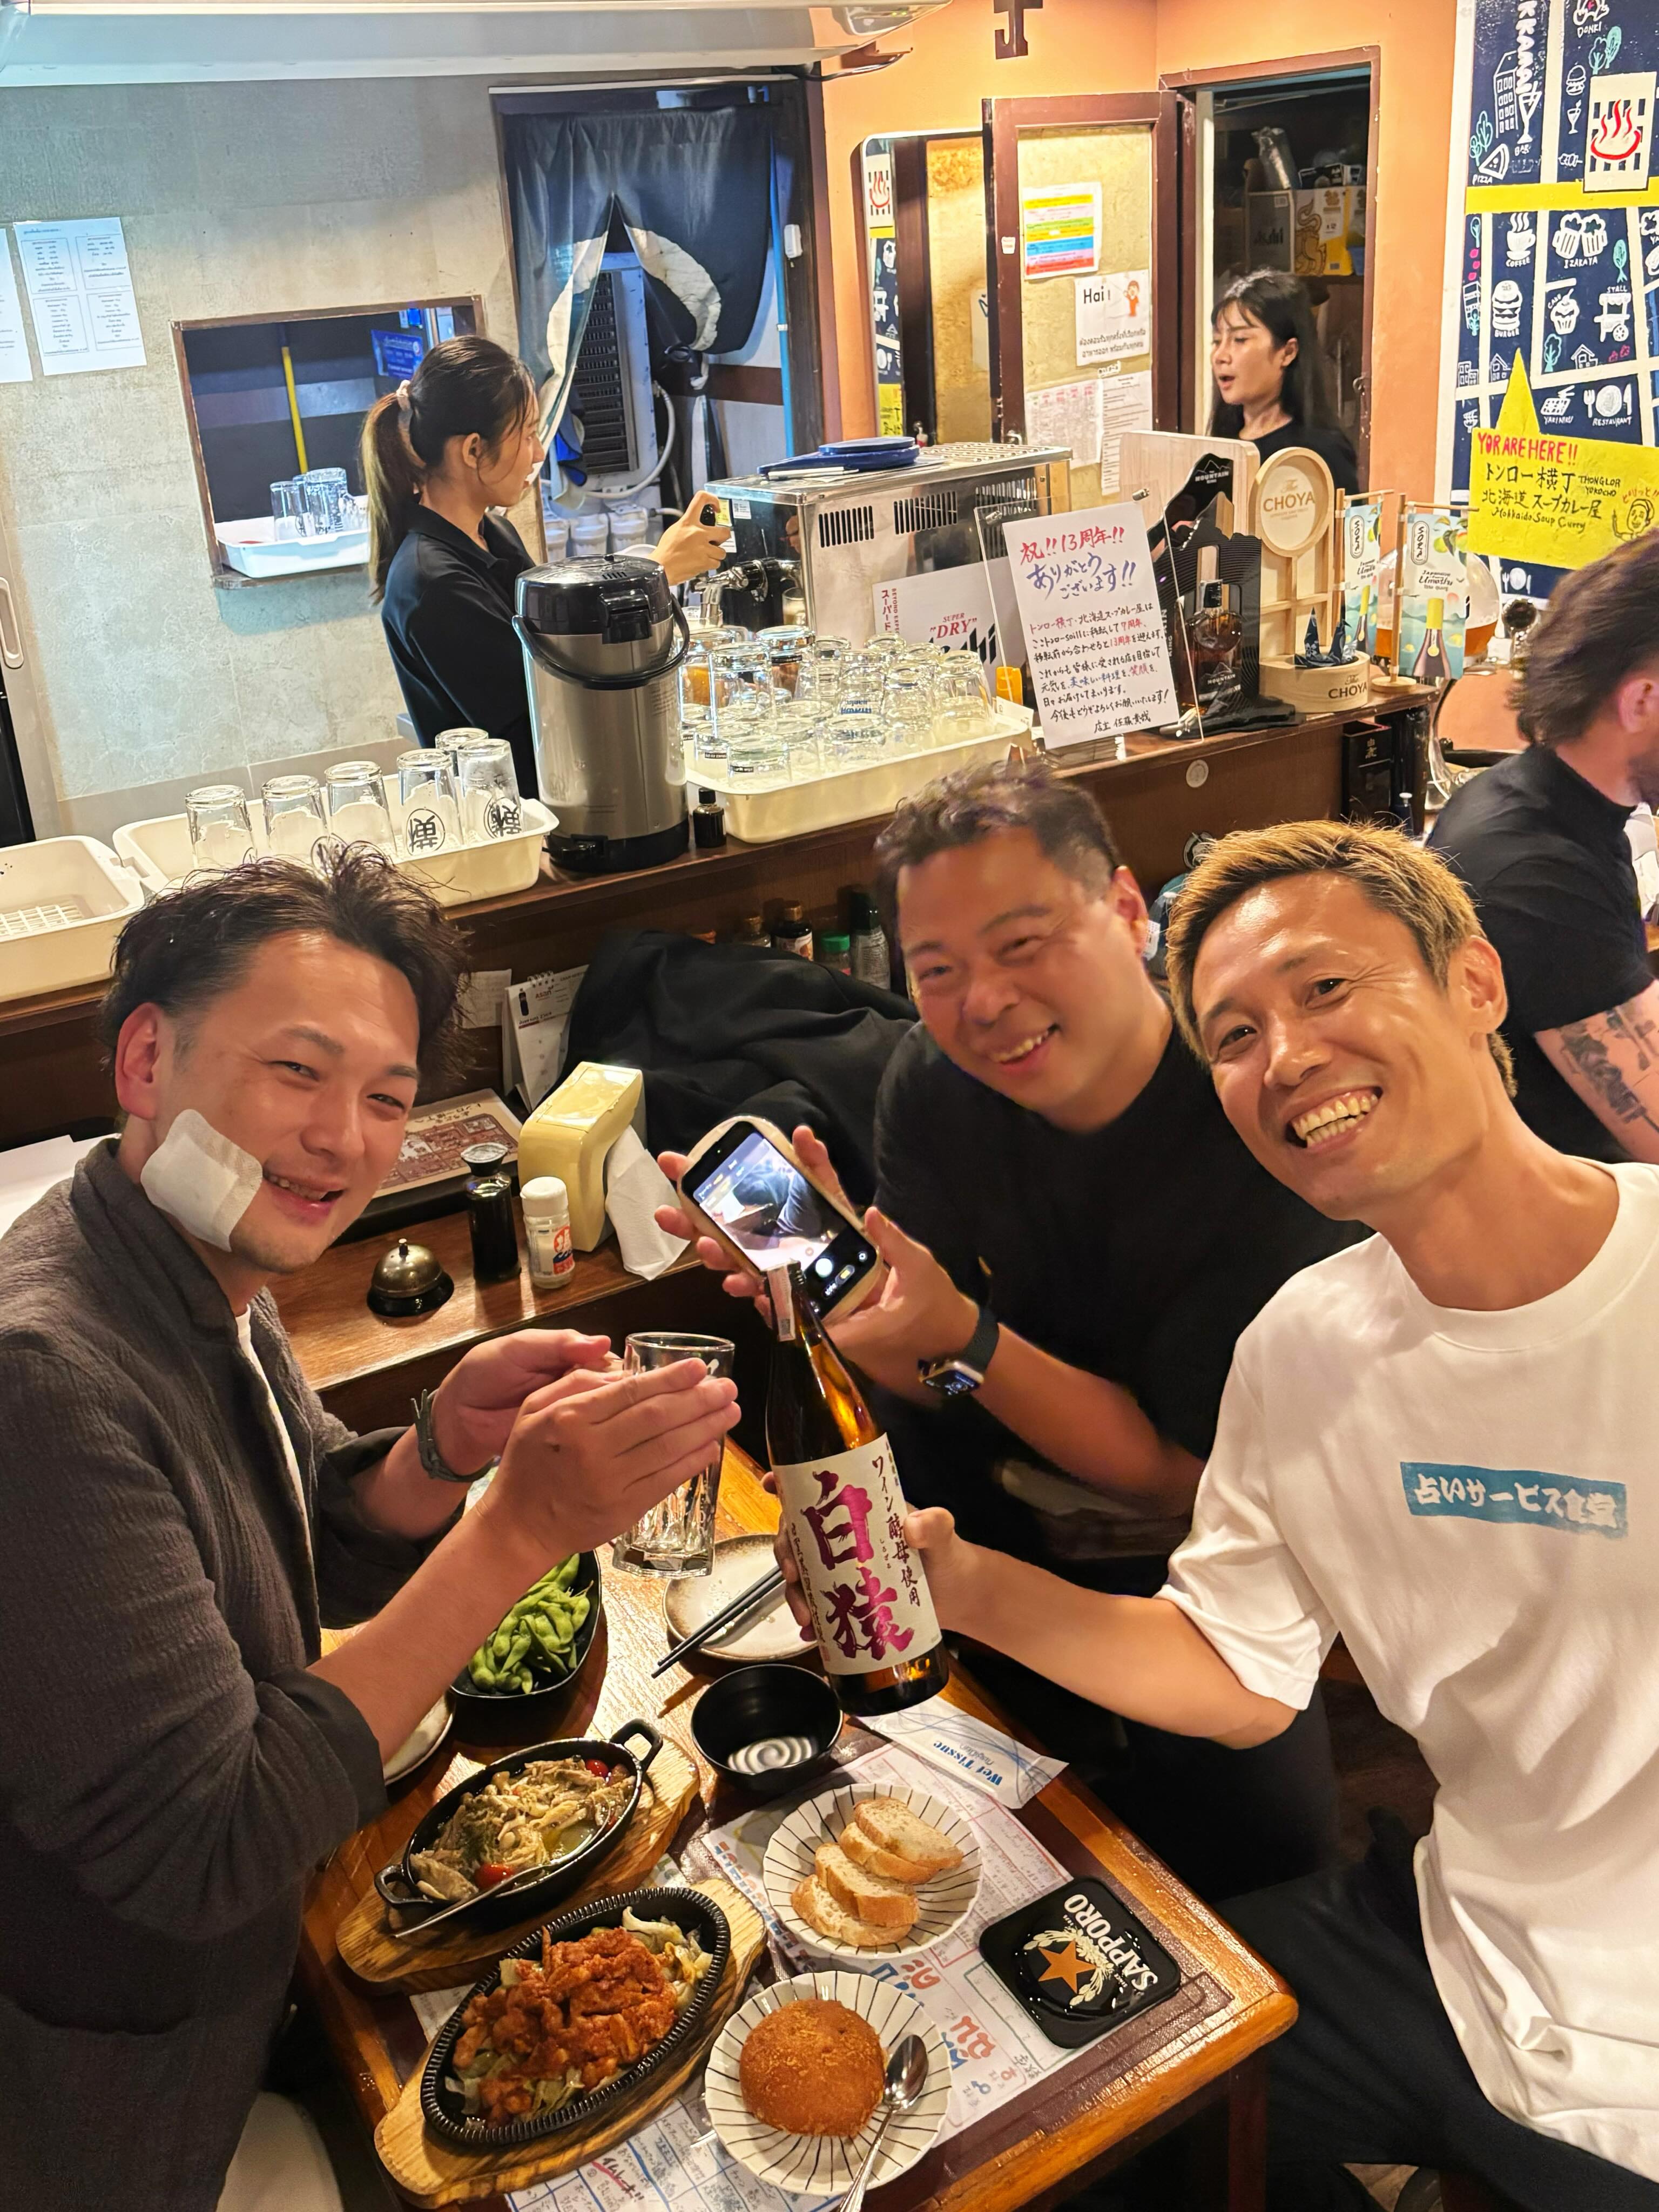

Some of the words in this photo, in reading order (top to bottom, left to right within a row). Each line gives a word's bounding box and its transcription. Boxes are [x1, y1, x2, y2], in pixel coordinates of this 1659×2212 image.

[1577, 22, 1602, 38] DONKI
[1515, 0, 1537, 95] KKAMAI
[1472, 174, 1493, 185] PIZZA
[1506, 257, 1531, 267] COFFEE
[1564, 258, 1599, 269] IZAKAYA
[1083, 286, 1104, 304] Hai
[1607, 285, 1628, 293] STALL
[1593, 416, 1633, 428] RESTAURANT
[1502, 437, 1528, 458] ARE
[1195, 471, 1229, 482] MOUNTAIN
[1486, 462, 1577, 493] トンロー横丁
[1578, 475, 1621, 487] THONGLOR
[1263, 491, 1315, 512] CHOYA
[1482, 488, 1528, 509] 北海道
[1585, 486, 1616, 497] YOKOCHO
[1492, 508, 1532, 522] Hokkaido
[1533, 513, 1555, 526] Soup
[1558, 516, 1586, 534] Curry
[1027, 552, 1102, 601] ありがとう
[881, 589, 893, 633] スーパード
[943, 612, 965, 623] SUPER
[1208, 674, 1236, 684] MOUNTAIN
[1328, 680, 1368, 700] CHOYA
[872, 1455, 920, 1607] ワイン酵母使用
[800, 1469, 915, 1661] 白猿
[933, 1740, 975, 1769] Tissue
[975, 1766, 1003, 1786] Wet
[1063, 1893, 1158, 1991] SAPPORO
